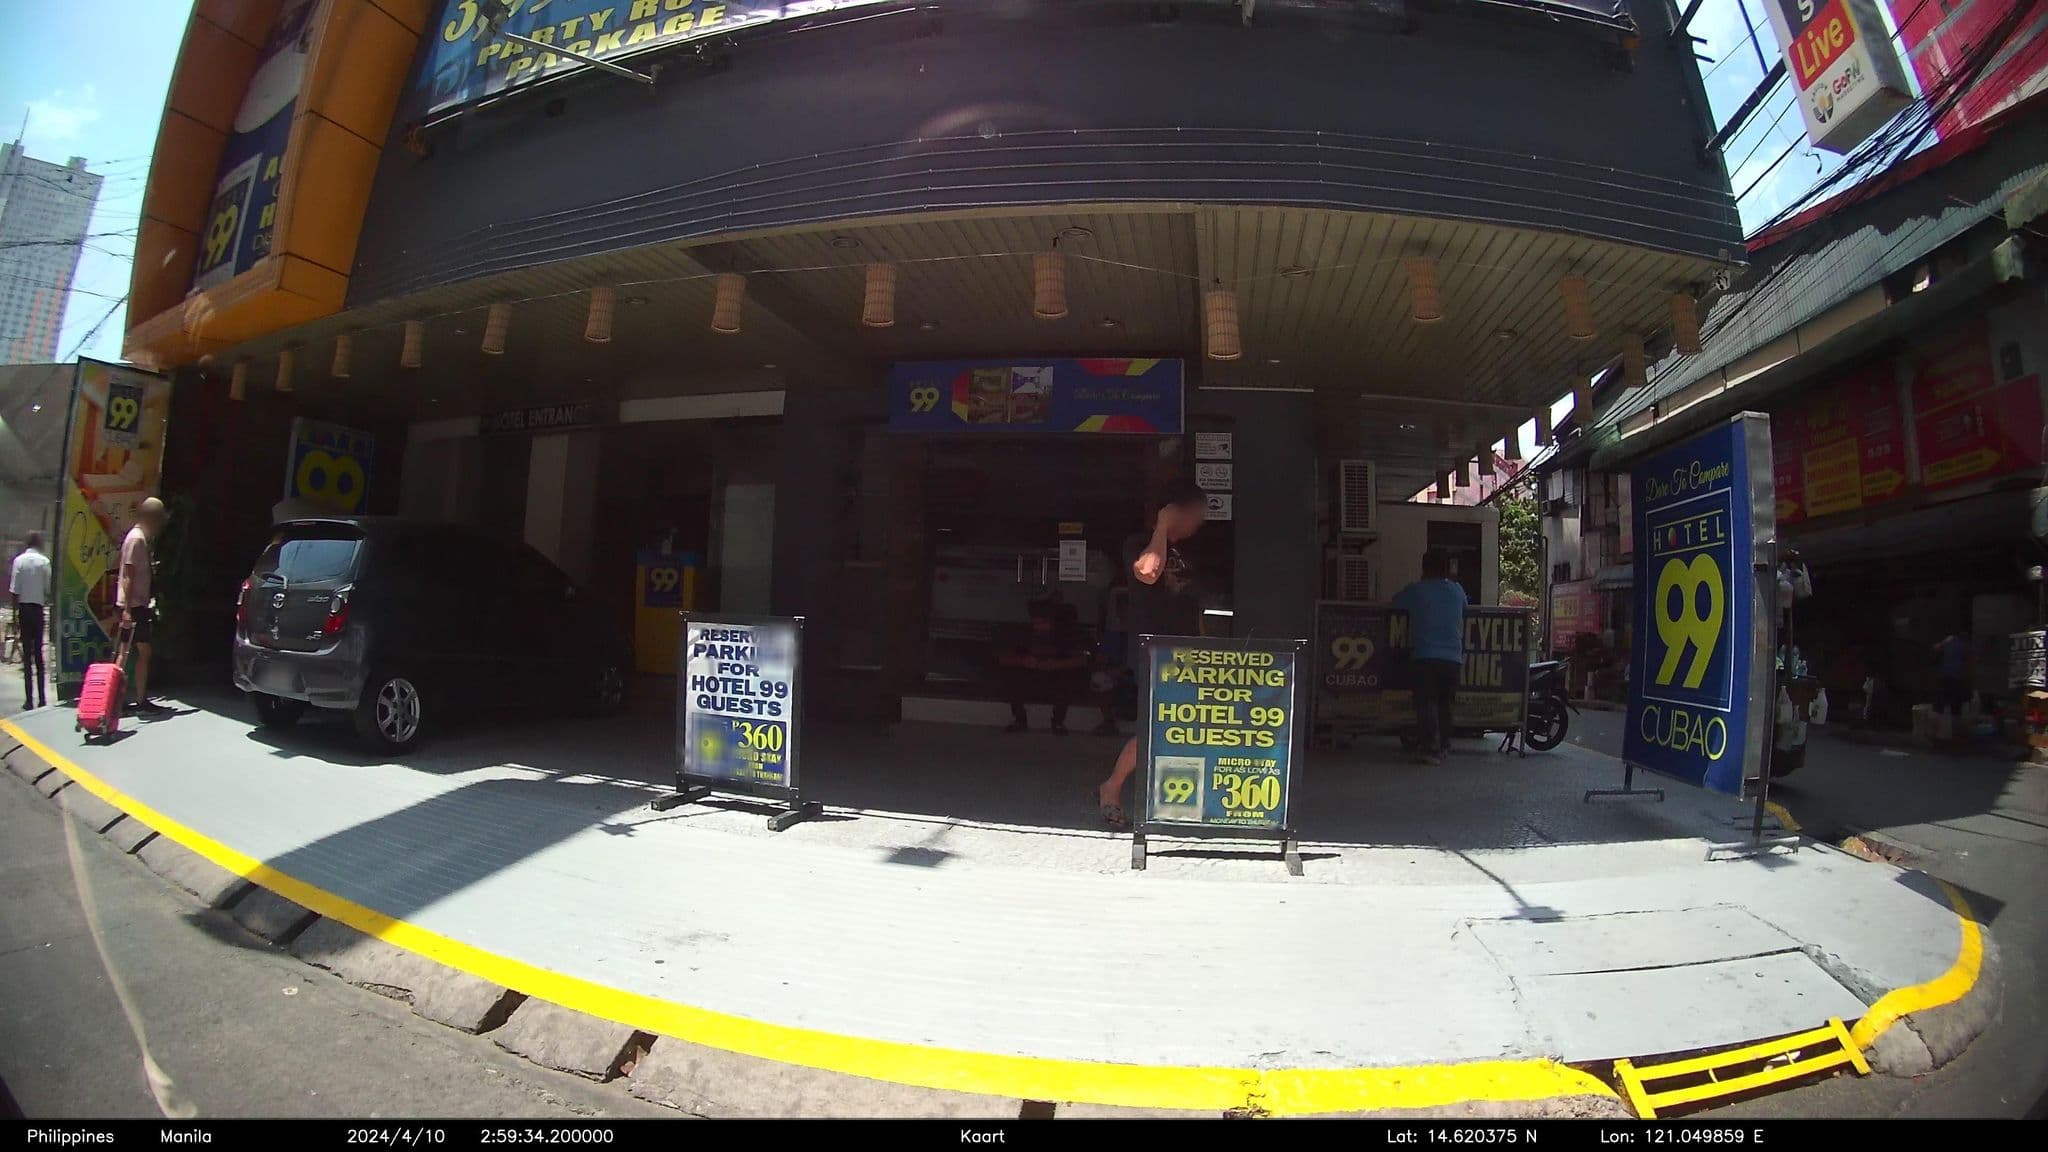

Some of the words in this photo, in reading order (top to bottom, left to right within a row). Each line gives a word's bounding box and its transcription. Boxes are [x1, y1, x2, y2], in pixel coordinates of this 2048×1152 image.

[476, 7, 616, 66] PARTY
[504, 5, 727, 81] PACKAGE
[1797, 17, 1844, 79] Live
[203, 203, 239, 269] 99
[910, 387, 940, 412] 99
[111, 396, 139, 429] 99
[1689, 460, 1730, 491] Compare
[1653, 515, 1725, 552] HOTEL
[650, 567, 680, 593] 99
[1390, 613, 1525, 652] MCYCLE
[1655, 552, 1725, 689] 99
[700, 629, 760, 644] RESERV
[693, 643, 758, 661] PARKI
[1173, 650, 1274, 666] RESERVED
[1331, 636, 1376, 670] 99
[717, 662, 760, 677] FOR
[1160, 666, 1285, 687] PARKING
[1326, 674, 1378, 687] CUBAO
[692, 674, 756, 696] HOTEL
[759, 680, 789, 699] 99
[1198, 687, 1252, 702] FOR
[696, 694, 782, 716] GUESTS
[1158, 703, 1243, 725] HOTEL
[1250, 707, 1285, 727] 99
[1165, 726, 1275, 747] GUESTS
[1640, 704, 1728, 760] CUBAO
[1218, 757, 1251, 767] MICRO
[1234, 766, 1246, 774] AS
[1163, 776, 1195, 803] 99
